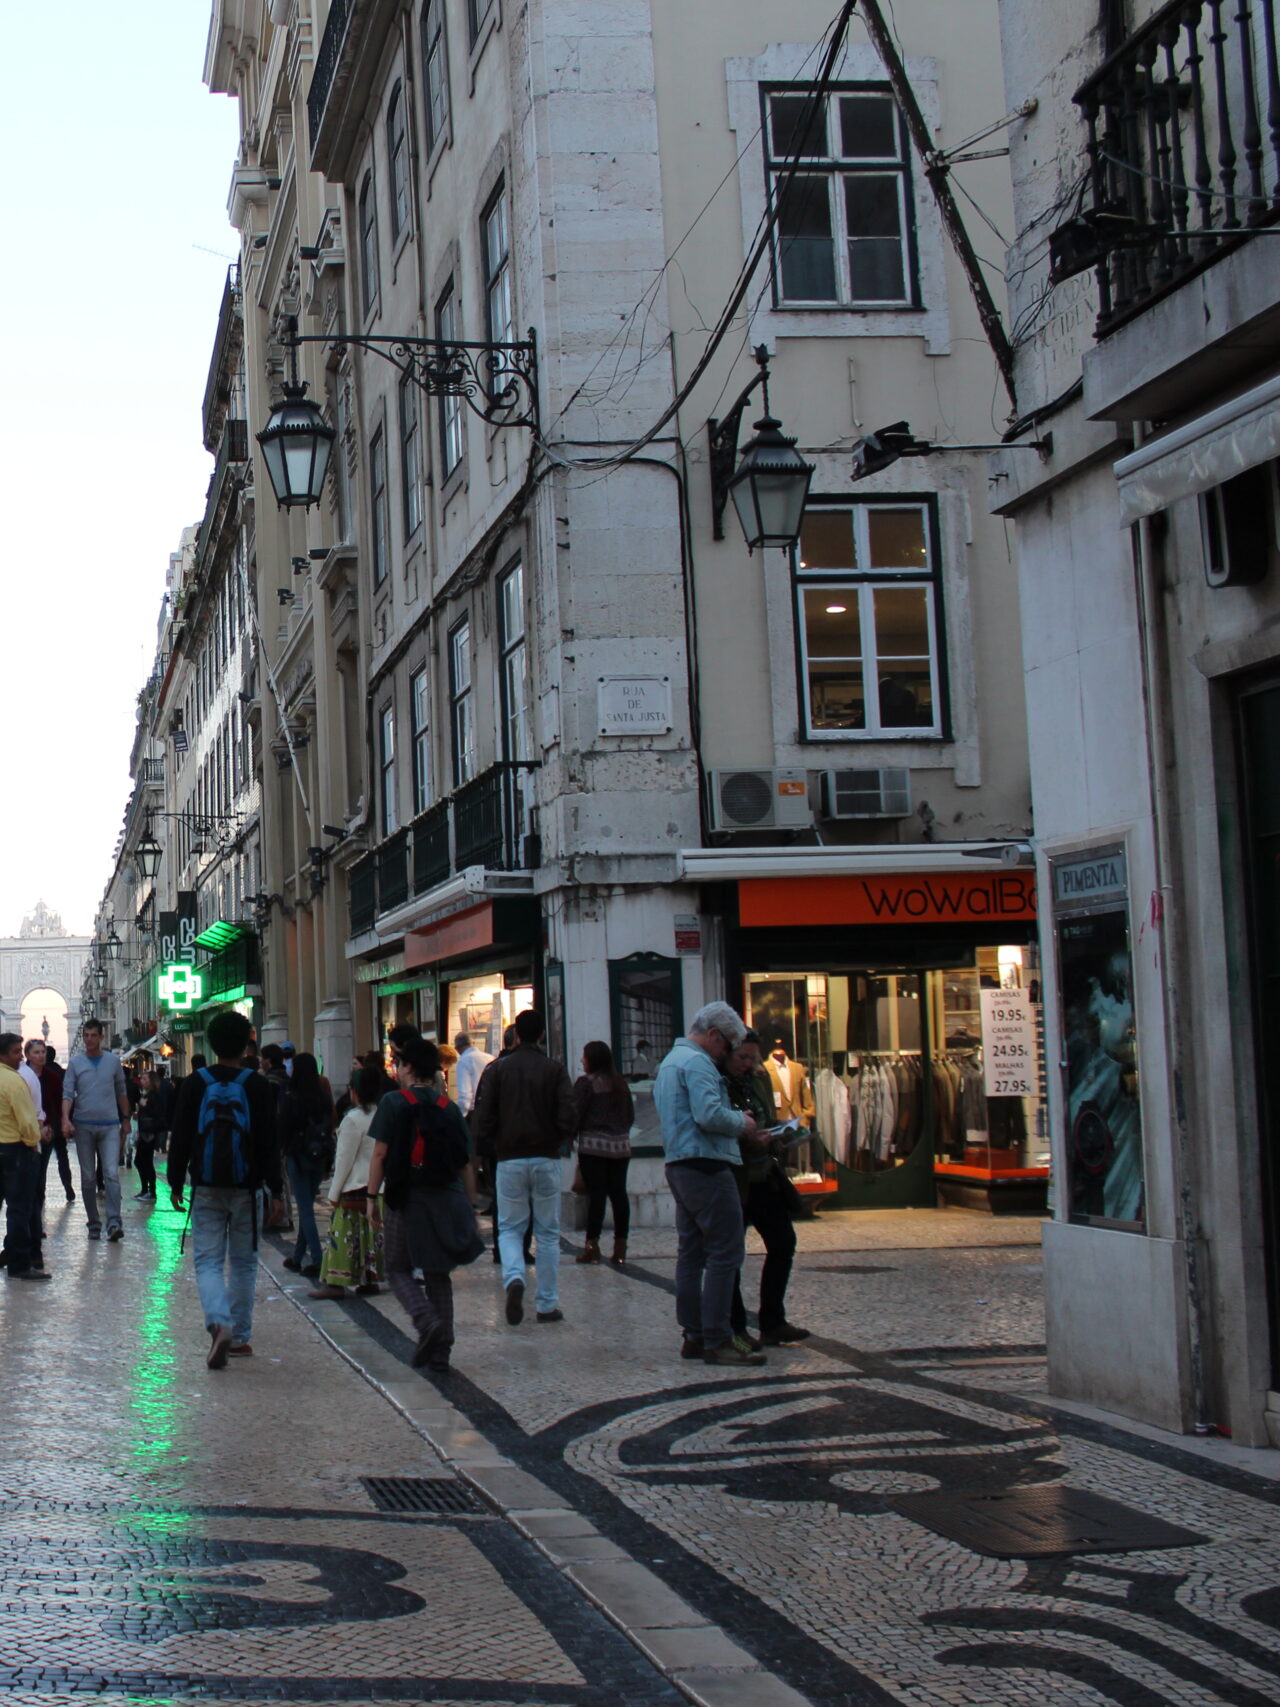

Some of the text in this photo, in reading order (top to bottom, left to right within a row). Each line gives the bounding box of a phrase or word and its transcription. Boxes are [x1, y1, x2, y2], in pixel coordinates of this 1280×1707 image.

[622, 687, 646, 696] RUA
[628, 699, 642, 709] DE
[606, 711, 666, 722] SANTA JUSTA
[1062, 862, 1119, 893] PIMENTA
[991, 1009, 1027, 1021] 19.95€
[992, 1044, 1029, 1057] 24.95€
[994, 1080, 1031, 1092] 27.95€
